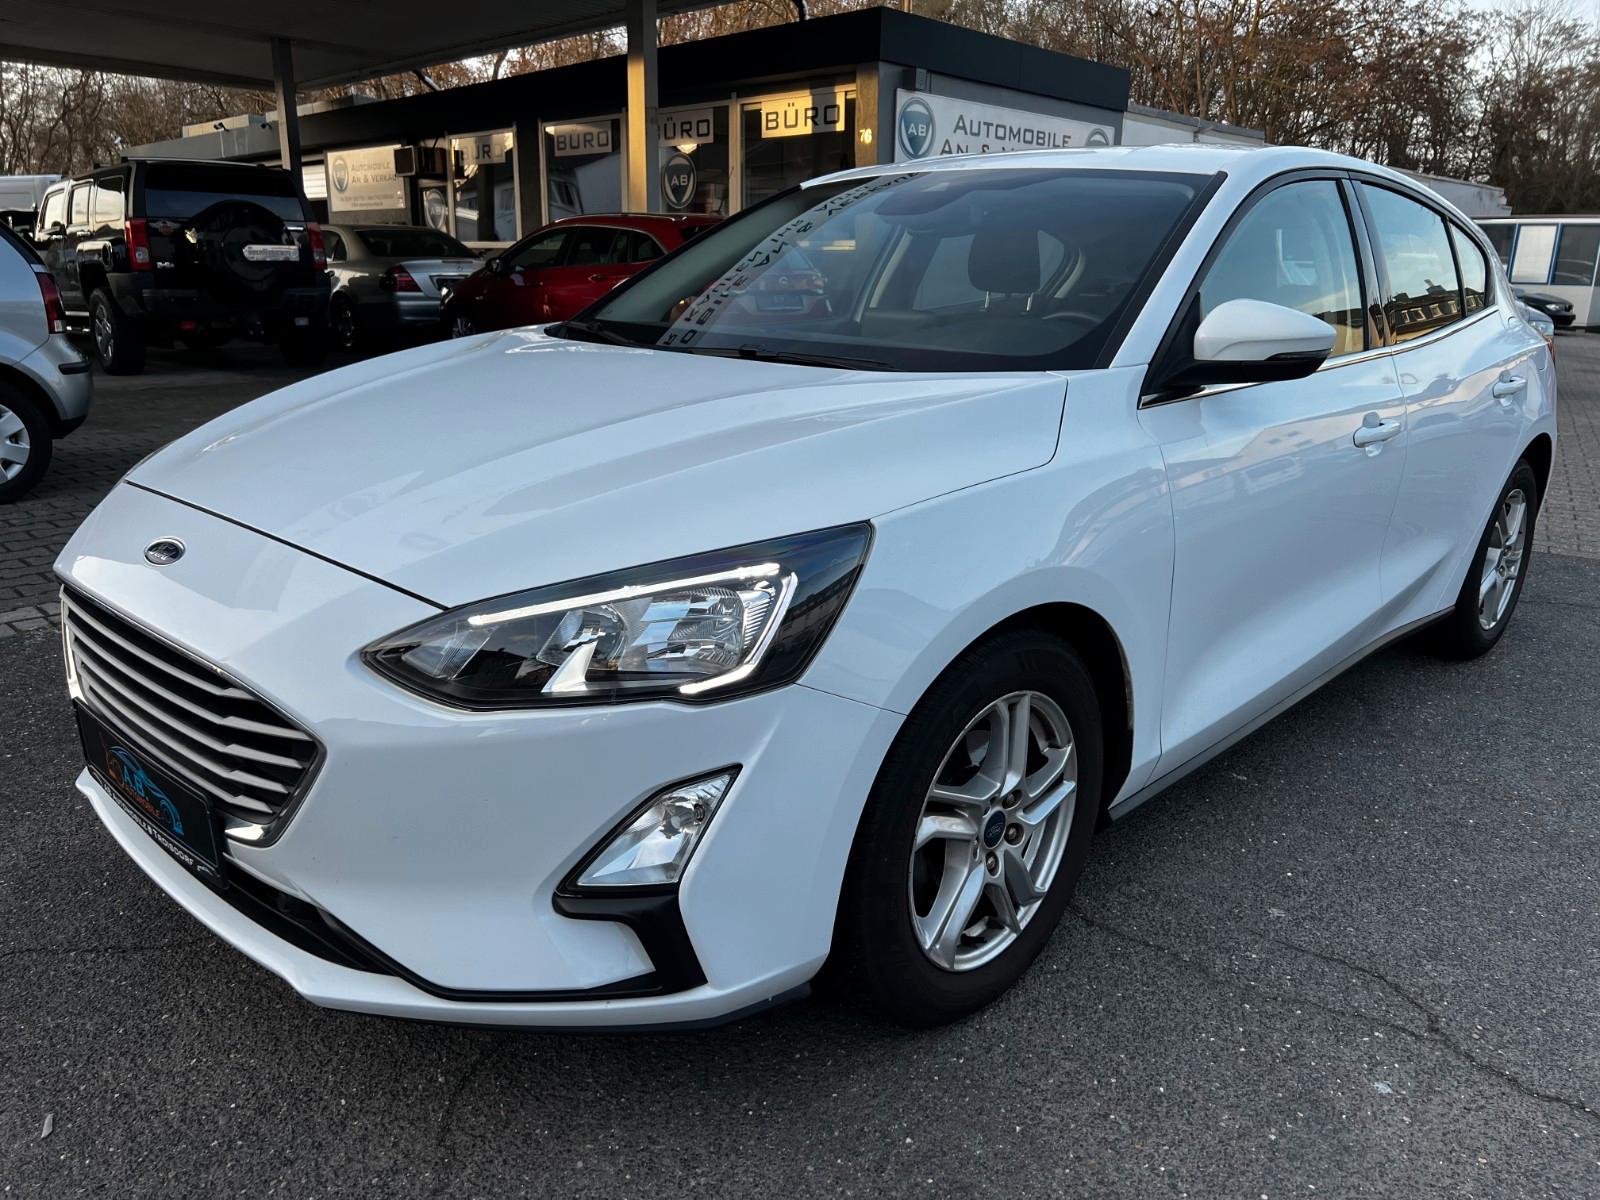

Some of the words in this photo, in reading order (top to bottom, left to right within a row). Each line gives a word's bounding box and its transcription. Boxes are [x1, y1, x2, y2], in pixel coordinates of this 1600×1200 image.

[657, 116, 710, 140] ÜRO
[765, 102, 840, 131] BÜRO
[556, 127, 609, 151] BÜRO
[859, 128, 872, 144] 76
[907, 122, 926, 137] AB
[953, 114, 1072, 148] AUTOMOBILE
[670, 174, 688, 186] AB
